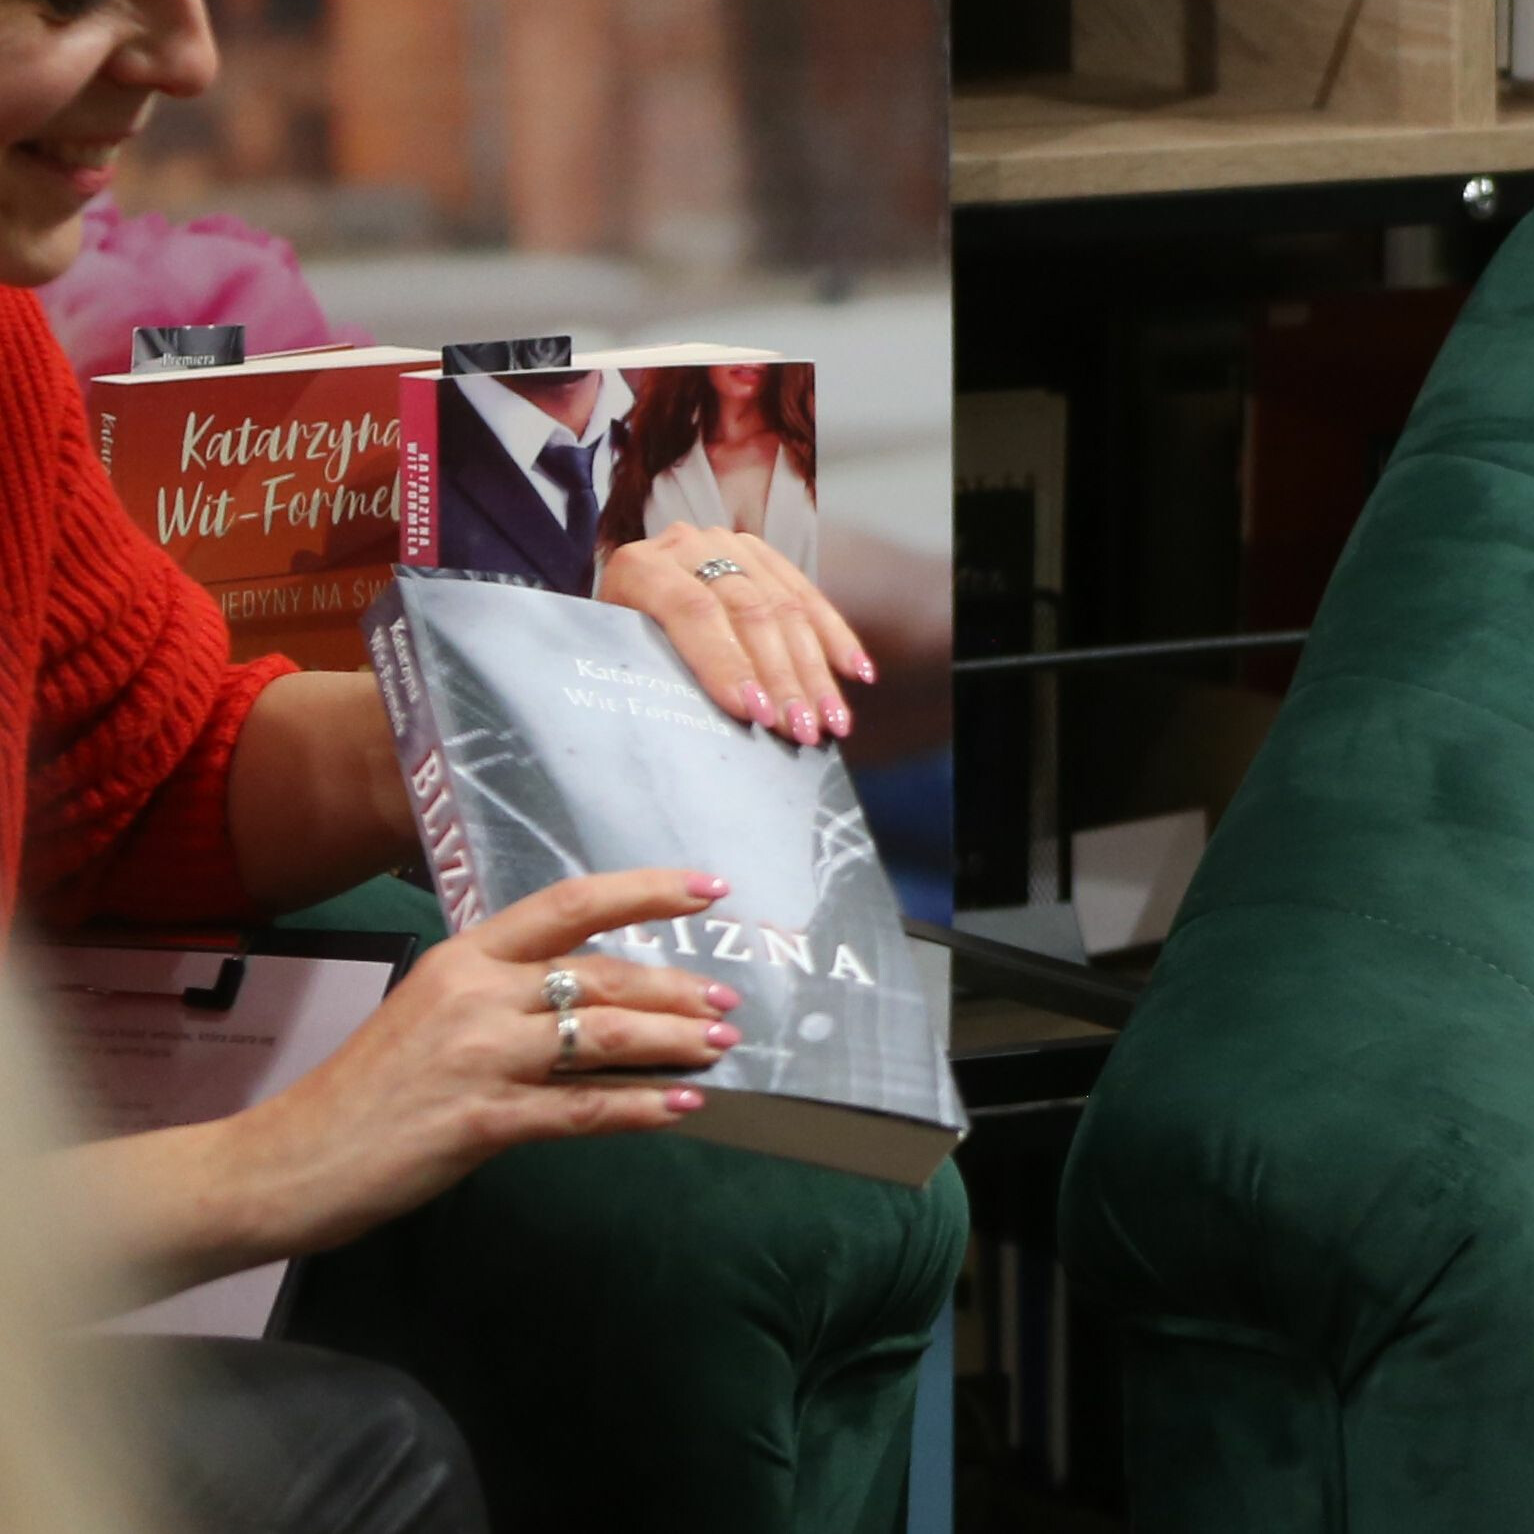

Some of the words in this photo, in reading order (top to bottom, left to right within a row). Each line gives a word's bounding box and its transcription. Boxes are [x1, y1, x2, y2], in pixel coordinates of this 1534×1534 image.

[161, 351, 216, 366] Premiera
[180, 410, 400, 483] Katarzyna
[157, 466, 400, 546] Wit-Formel
[406, 441, 419, 557] WIT-FORMELA
[417, 452, 431, 548] KATARZYNA
[312, 582, 343, 612] NA
[574, 657, 702, 702] Katarzyna
[411, 748, 484, 934] BLIZN
[587, 915, 876, 987] LIZNA
